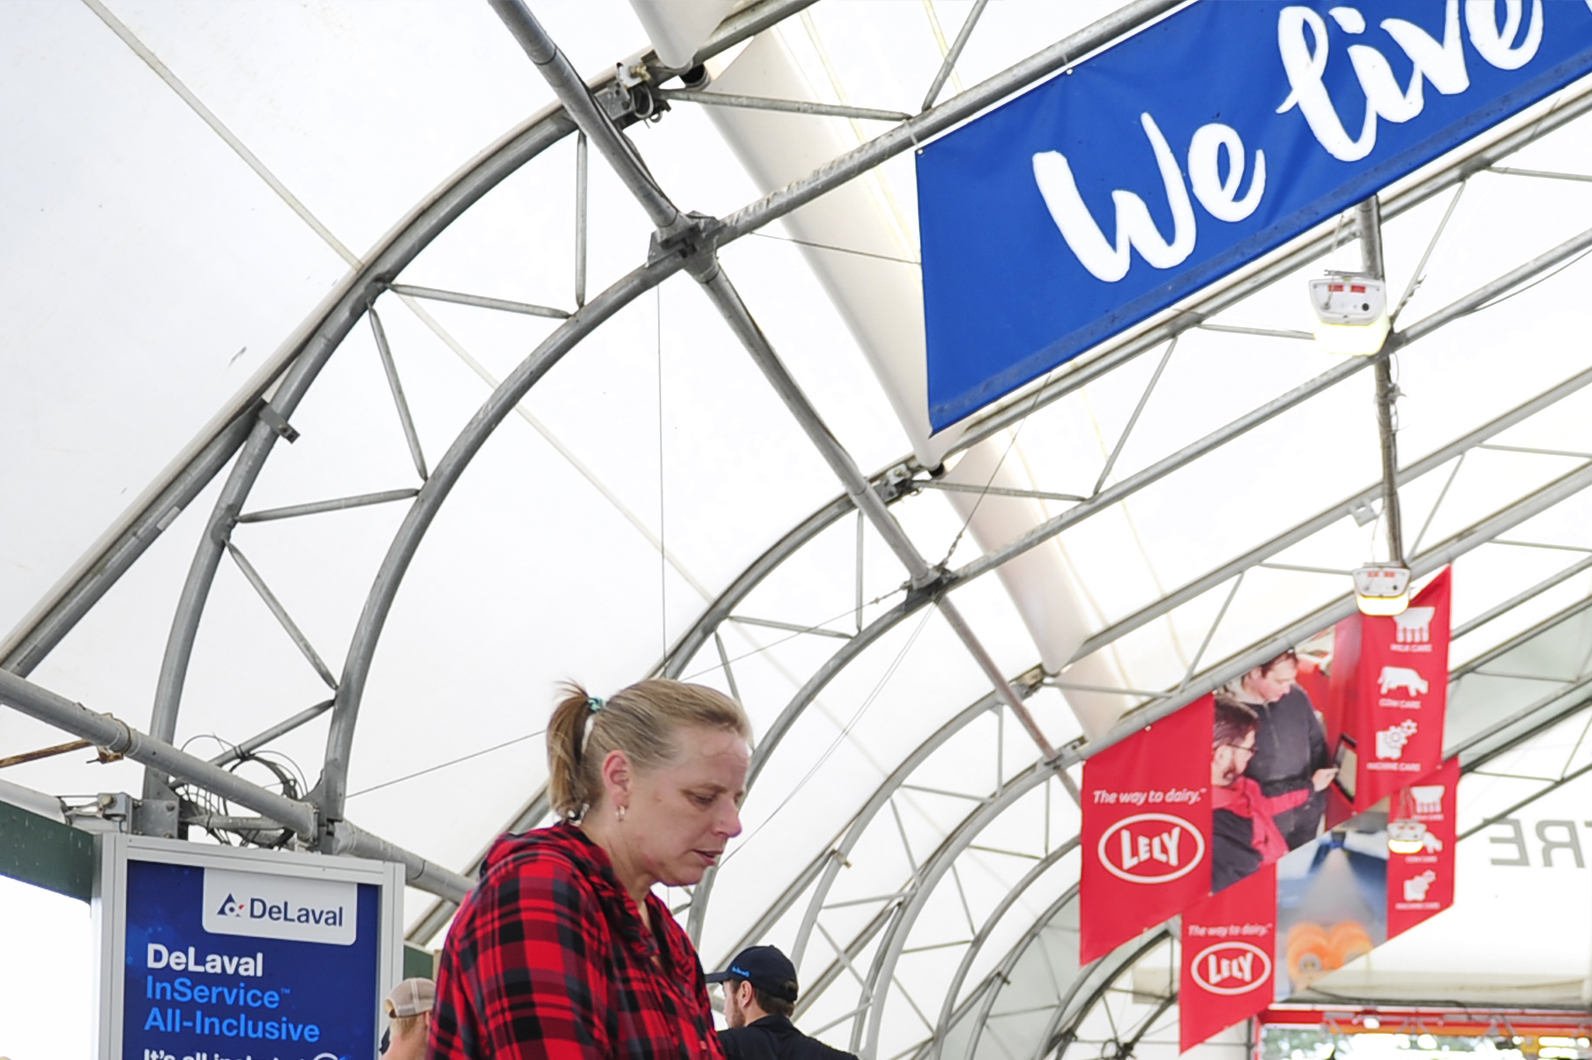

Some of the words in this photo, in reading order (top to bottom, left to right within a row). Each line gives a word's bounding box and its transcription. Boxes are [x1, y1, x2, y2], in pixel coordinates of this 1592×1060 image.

[1032, 112, 1266, 283] We
[1276, 0, 1544, 162] live
[1093, 789, 1118, 804] The
[1119, 792, 1147, 806] way
[1148, 789, 1163, 803] to
[1120, 826, 1181, 871] LELY
[249, 897, 344, 927] DeLaval
[1188, 924, 1207, 937] The
[1208, 926, 1228, 938] way
[1229, 924, 1240, 936] to
[146, 942, 264, 977] DeLaval
[1208, 951, 1253, 985] LELY
[143, 1006, 321, 1043] All-Inclusive
